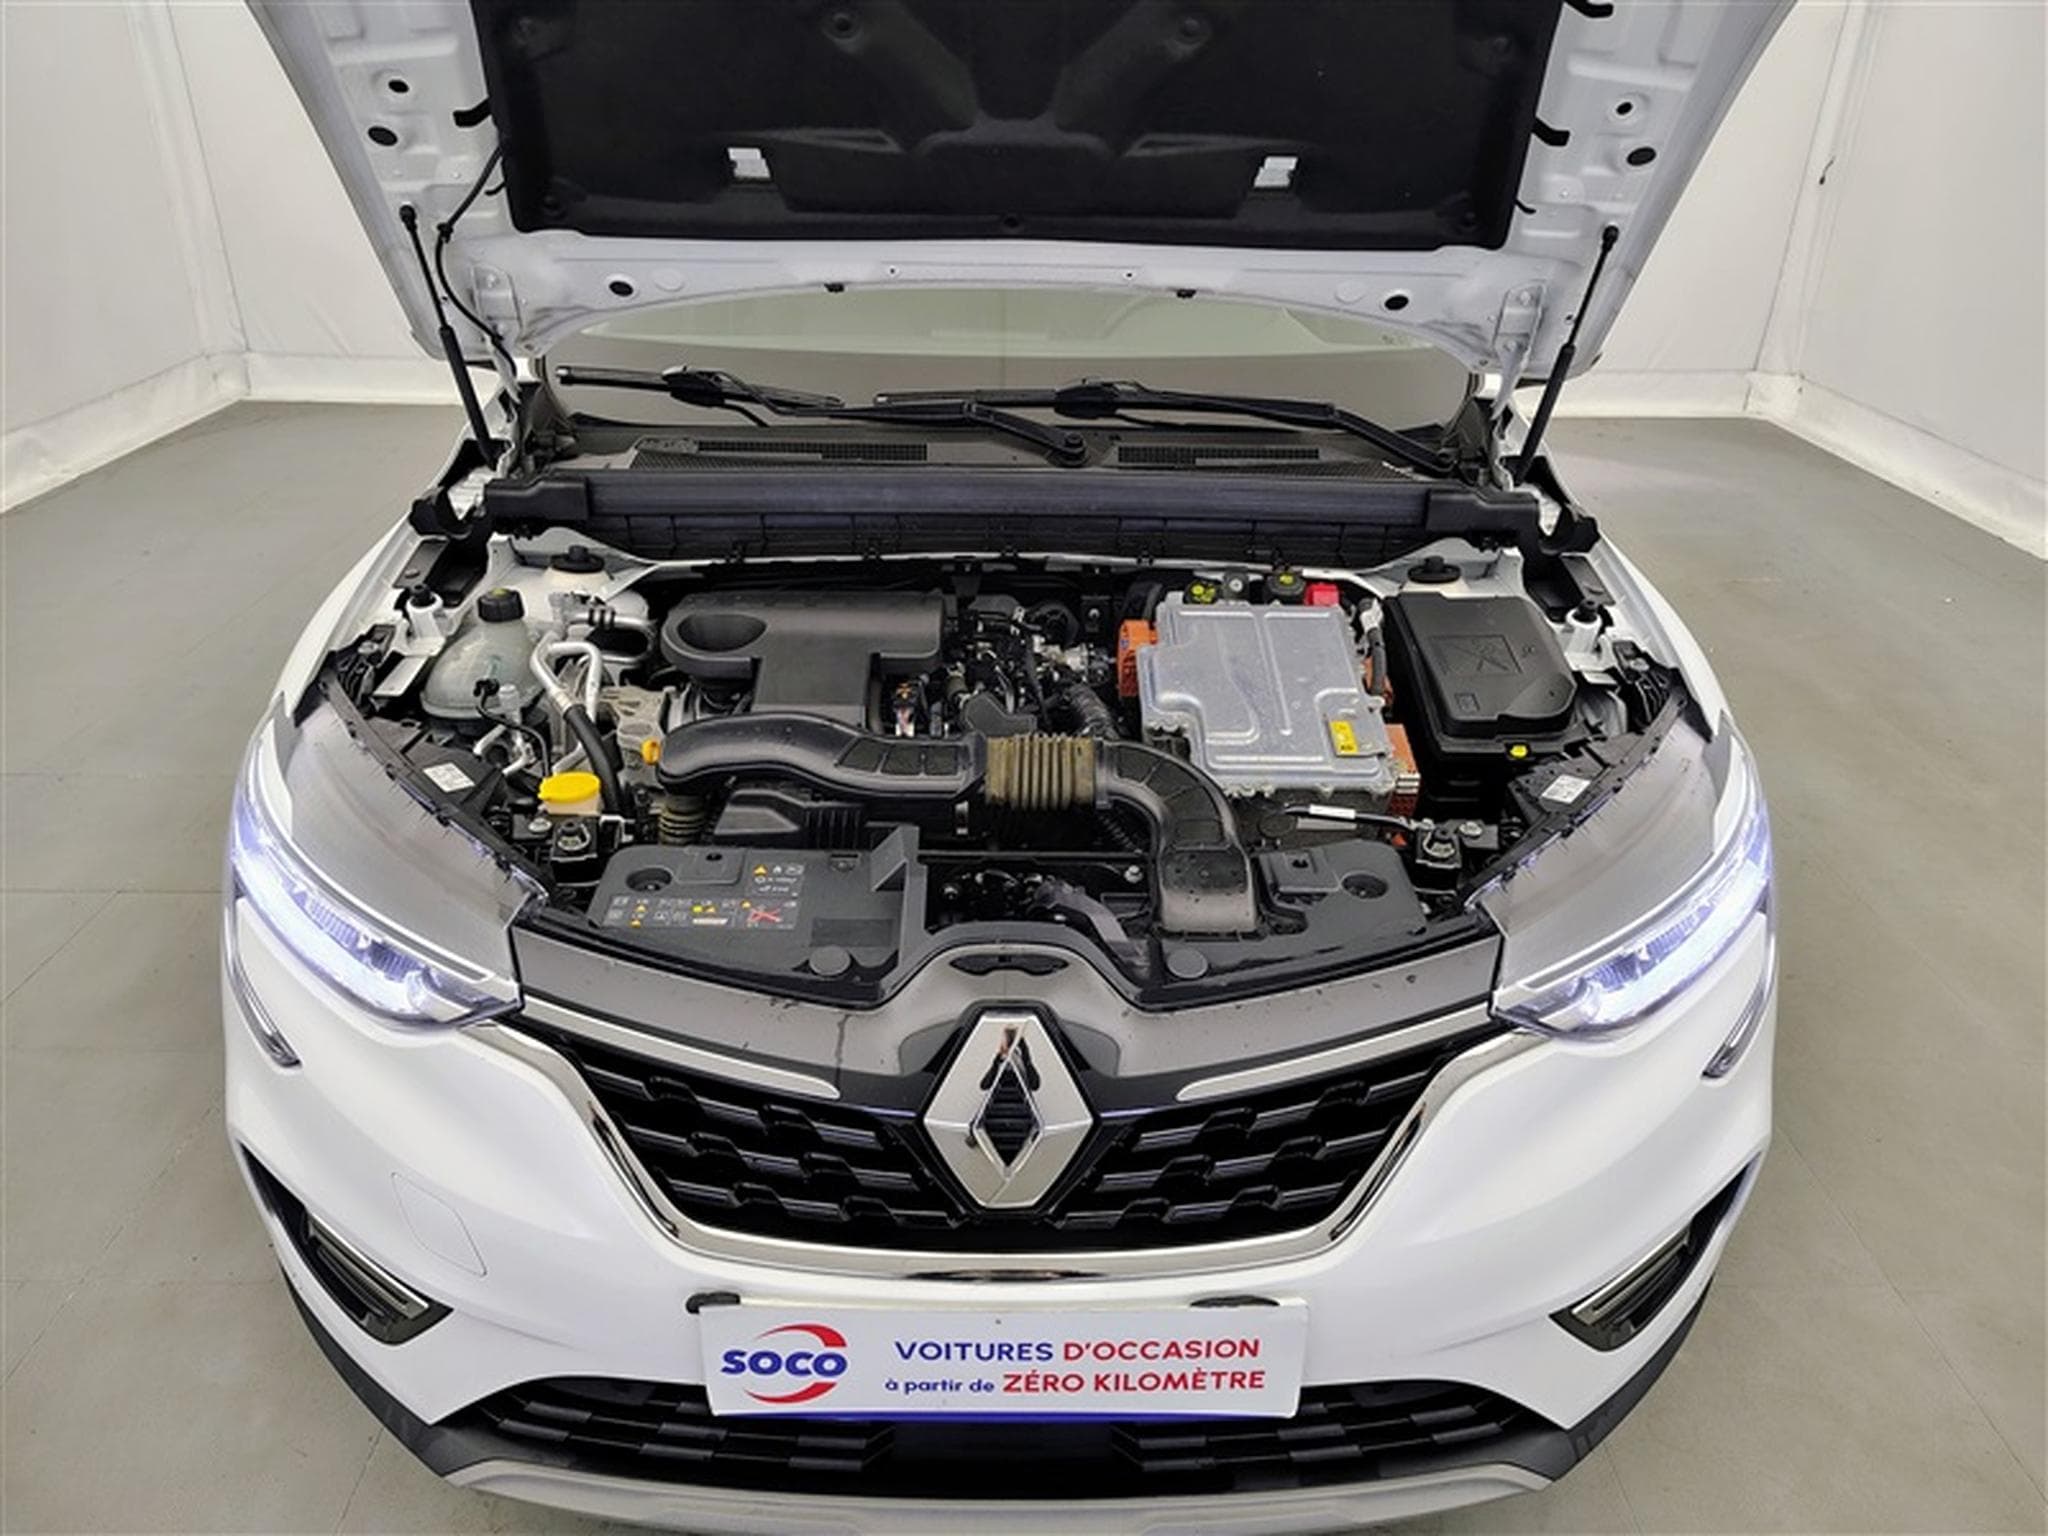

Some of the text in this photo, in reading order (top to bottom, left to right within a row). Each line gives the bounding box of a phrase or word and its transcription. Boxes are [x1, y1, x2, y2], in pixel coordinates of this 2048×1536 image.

[721, 1350, 848, 1377] SOCO
[895, 1339, 1260, 1361] VOITURES D'OCCASION
[885, 1367, 1266, 1395] à partir de ZÉRO KILOMÈTRE
